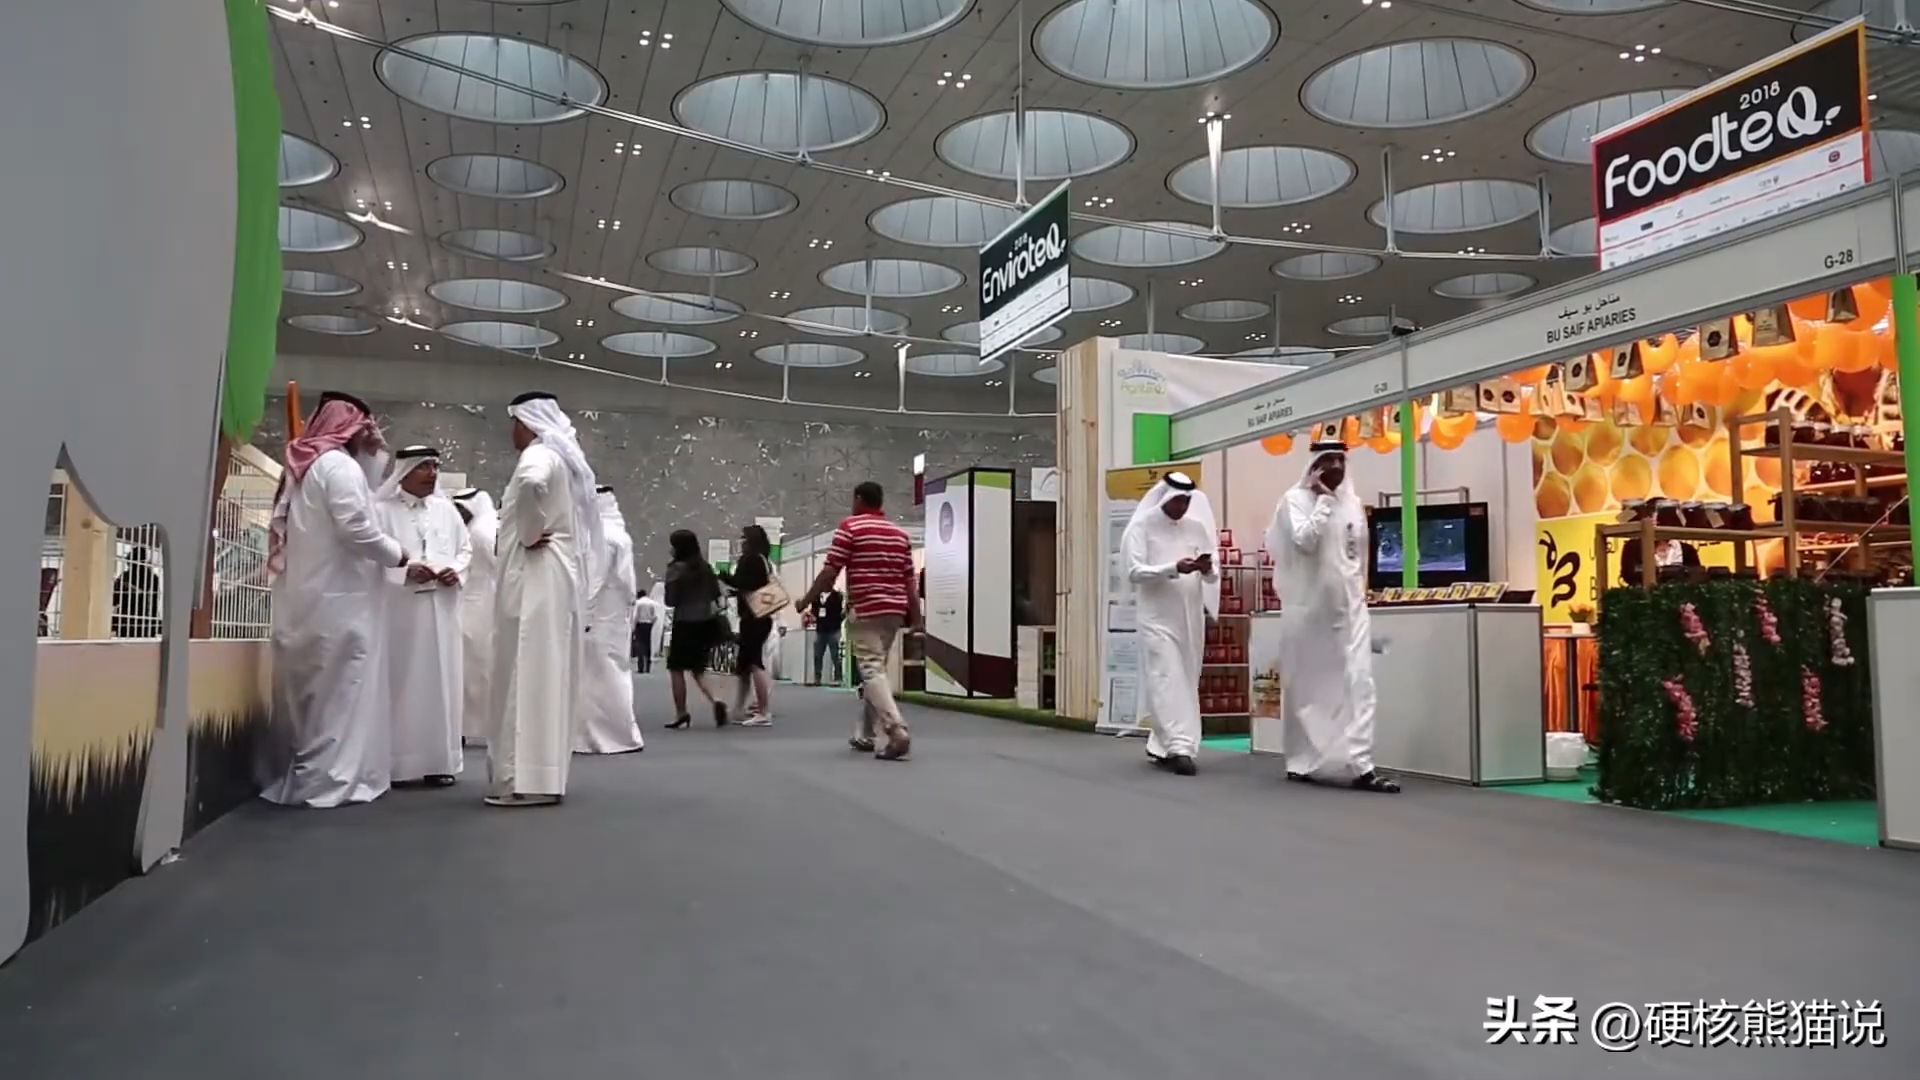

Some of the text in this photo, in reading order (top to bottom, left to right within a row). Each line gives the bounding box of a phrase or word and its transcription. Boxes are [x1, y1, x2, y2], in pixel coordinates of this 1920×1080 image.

[1740, 81, 1780, 110] 2018
[1824, 249, 1854, 269] G-28
[1546, 307, 1637, 343] BU SAIF APIARIES
